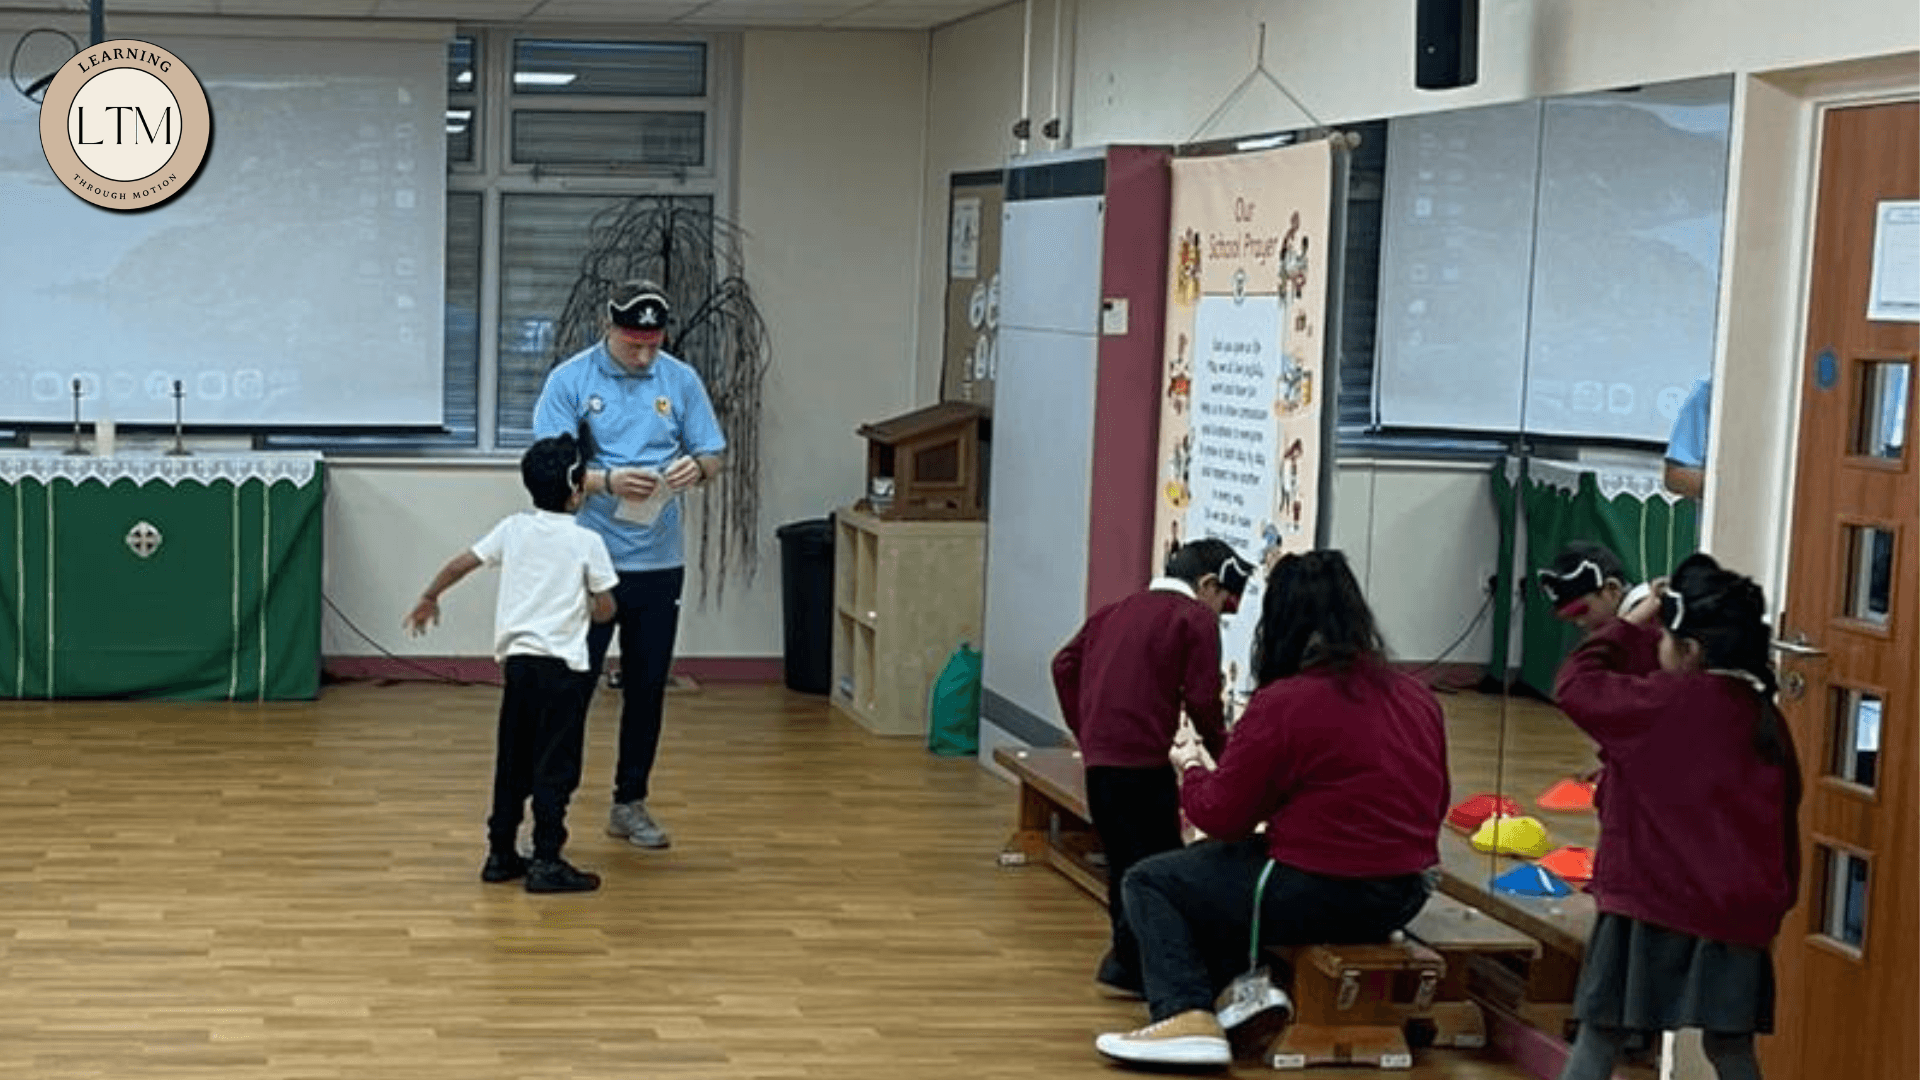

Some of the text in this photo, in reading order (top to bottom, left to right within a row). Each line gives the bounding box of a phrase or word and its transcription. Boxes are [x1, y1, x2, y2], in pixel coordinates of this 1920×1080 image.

[1234, 196, 1256, 222] Our
[1208, 232, 1279, 266] School Prayer
